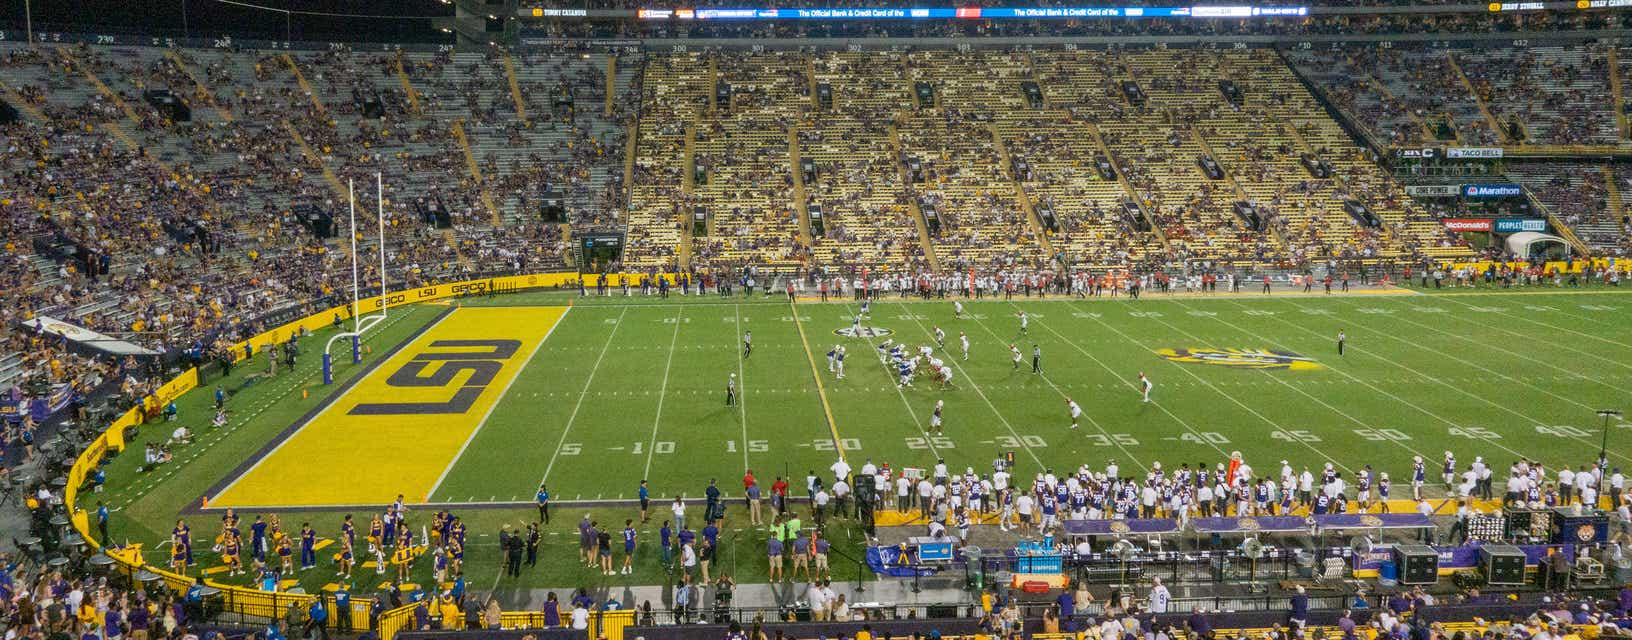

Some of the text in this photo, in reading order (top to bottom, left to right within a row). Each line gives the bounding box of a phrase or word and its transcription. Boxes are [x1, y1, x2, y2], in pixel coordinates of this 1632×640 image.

[798, 9, 810, 17] The
[811, 9, 830, 17] Official
[832, 9, 847, 17] Bank
[855, 9, 872, 17] Credit
[873, 9, 887, 17] Card
[894, 9, 904, 17] the
[1480, 187, 1520, 195] Marathon
[1499, 221, 1522, 230] PEOPLES
[418, 287, 437, 298] LSU
[451, 282, 487, 294] GEICO
[346, 339, 523, 415] LSU
[1271, 430, 1322, 442] 45
[1352, 428, 1412, 440] 50
[1448, 427, 1503, 439] 45
[1536, 425, 1592, 437] 40
[904, 437, 956, 449] 25
[995, 435, 1048, 448] 30
[1086, 434, 1140, 446] 35
[1180, 432, 1232, 444] 40
[560, 443, 583, 455] 5
[631, 441, 676, 454] 10
[727, 440, 769, 452] 15
[813, 438, 862, 451] 20
